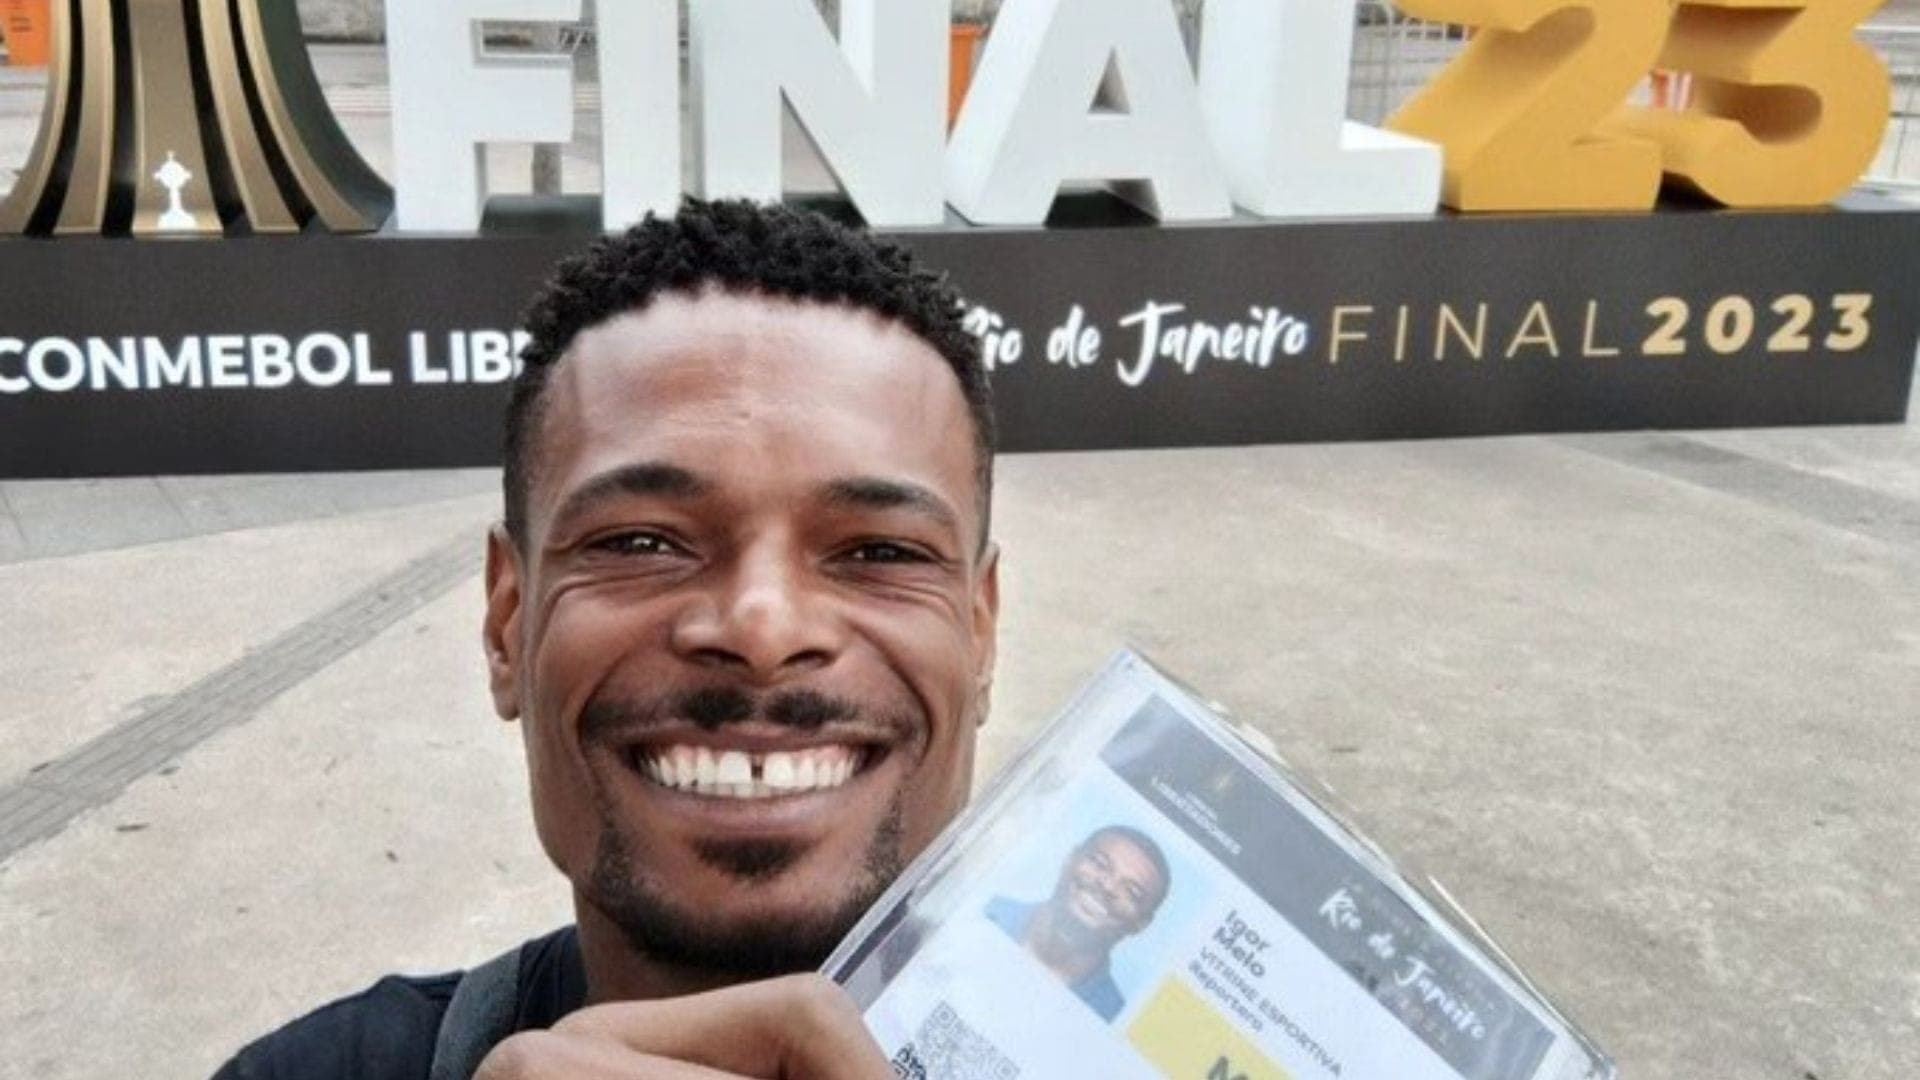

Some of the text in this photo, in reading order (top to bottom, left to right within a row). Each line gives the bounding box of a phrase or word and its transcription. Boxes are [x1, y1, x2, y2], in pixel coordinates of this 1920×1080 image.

[388, 0, 1891, 233] FINAL 23
[0, 331, 394, 393] CONMEBOL
[1046, 304, 1102, 369] de
[1116, 300, 1308, 387] Janeiro
[1328, 299, 1620, 364] FINAL
[1642, 293, 1873, 355] 2023
[1212, 925, 1265, 978] Melo
[1225, 909, 1271, 951] Igor
[1200, 946, 1260, 1002] VITRINE
[1258, 998, 1342, 1077] ESPORTIVA
